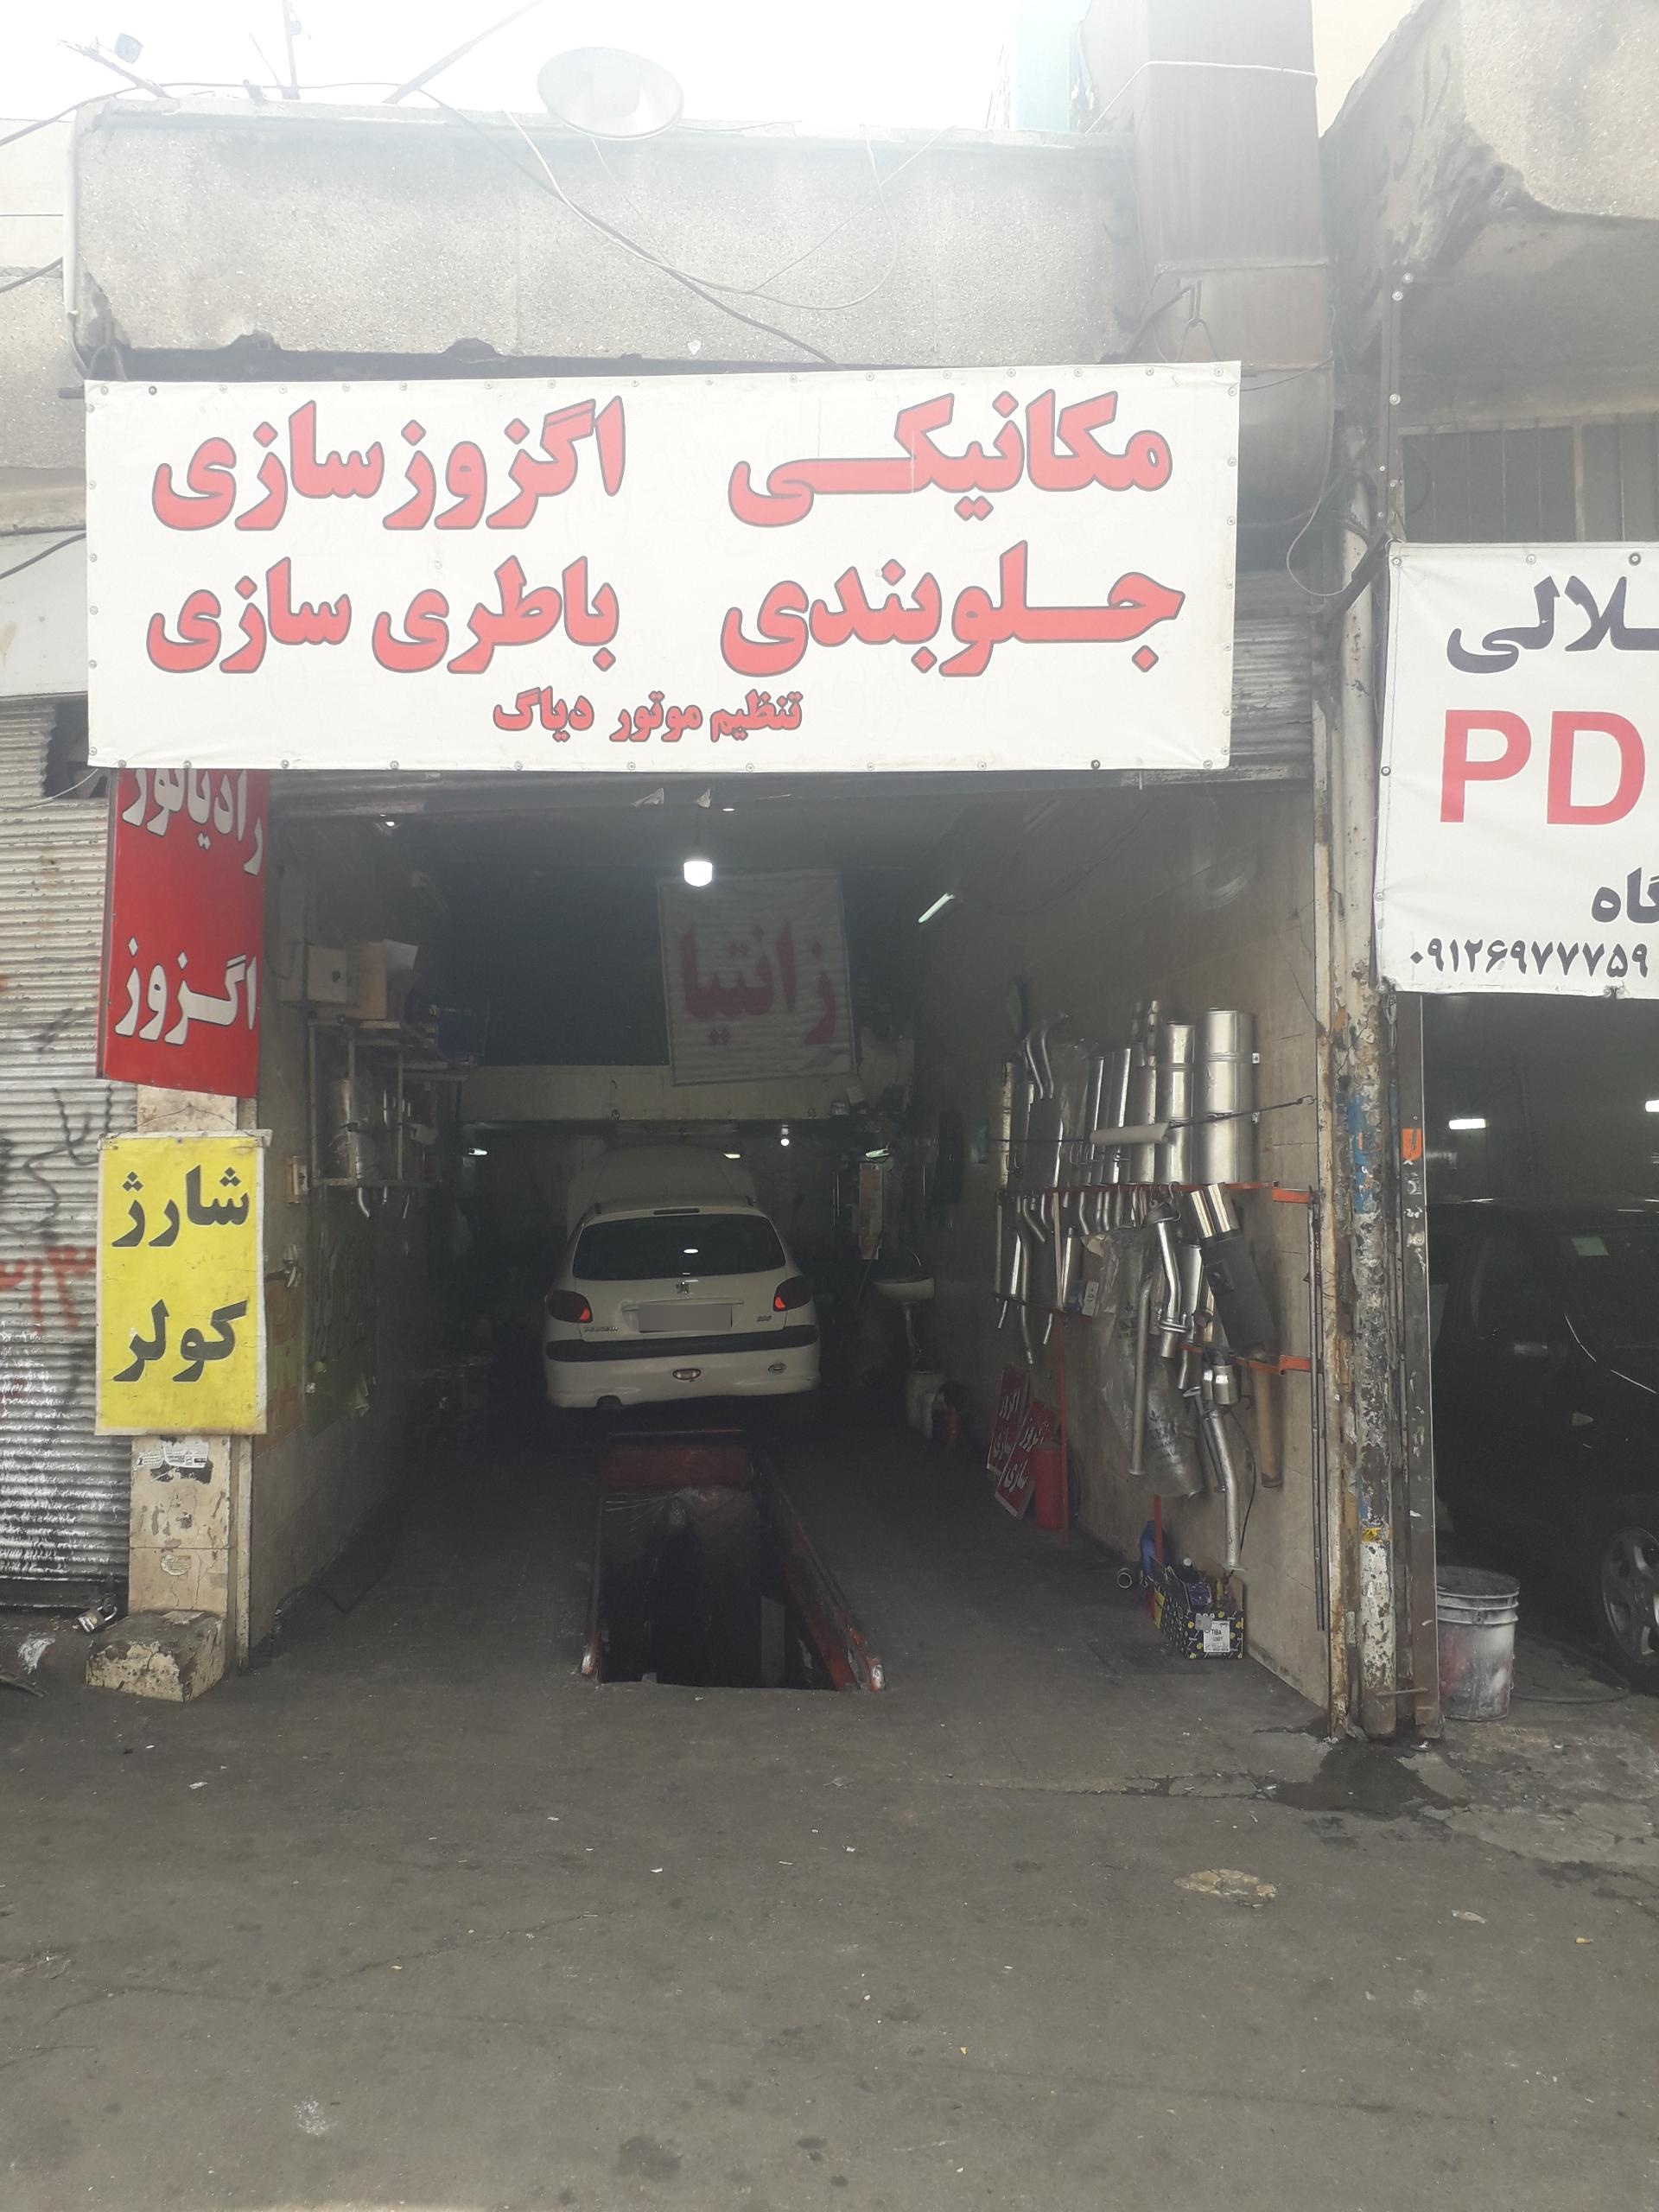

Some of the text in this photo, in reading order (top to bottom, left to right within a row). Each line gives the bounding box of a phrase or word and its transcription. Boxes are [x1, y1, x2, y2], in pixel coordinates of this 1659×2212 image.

[728, 389, 1173, 527] مکانیکی
[146, 539, 1185, 677] جلوبندی باطری سازی
[1447, 575, 1659, 673] لالی
[493, 685, 804, 743] تنظیم موتور دیاگ
[114, 937, 257, 1046] اگزوز
[1409, 938, 1649, 978] ۰۹۱۲۶۹۷۷۷۵۹
[111, 1164, 250, 1247] شارژ
[112, 1299, 247, 1382] کولر
